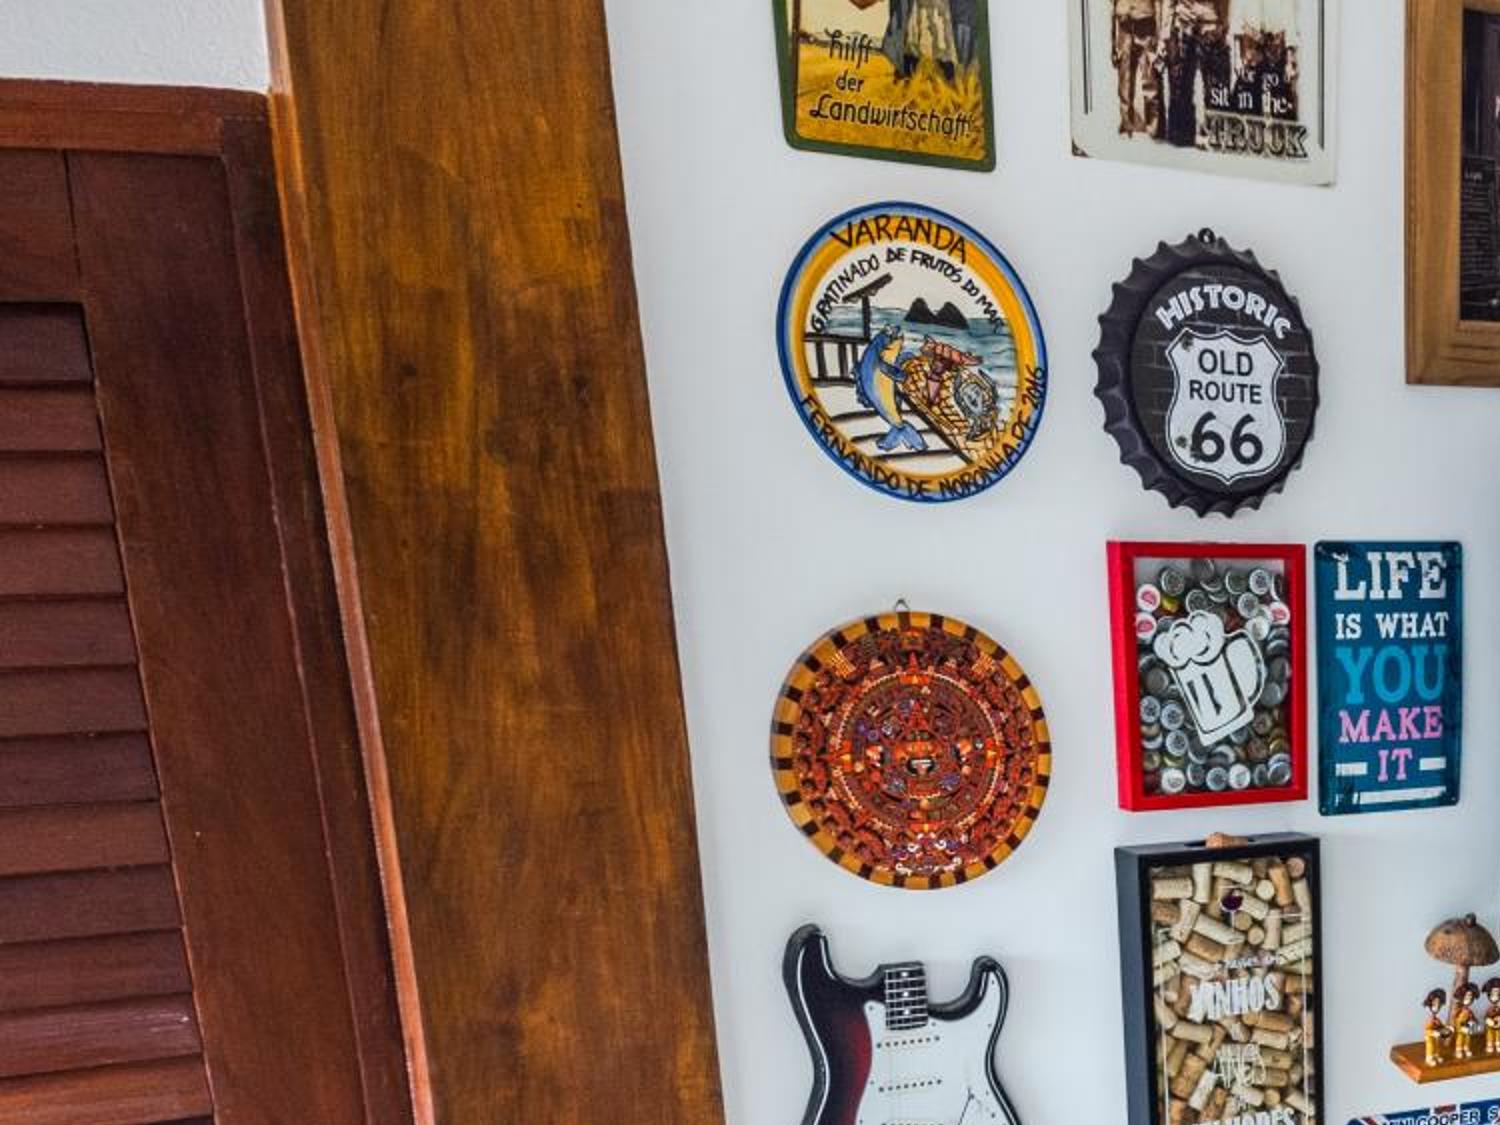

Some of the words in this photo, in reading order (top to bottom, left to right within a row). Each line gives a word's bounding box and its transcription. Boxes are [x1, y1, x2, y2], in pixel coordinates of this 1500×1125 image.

[835, 69, 865, 92] der
[1211, 83, 1230, 107] sit
[1238, 86, 1253, 110] in
[1201, 116, 1308, 158] TRUCK
[830, 214, 968, 265] VARANDA
[810, 253, 881, 335] GRATINADO
[886, 247, 905, 264] DE
[910, 250, 963, 284] FRUTOS
[960, 278, 980, 298] DO
[975, 294, 1005, 334] MAR
[1155, 284, 1292, 340] HISTORIC
[1198, 349, 1254, 377] OLD
[1189, 380, 1263, 404] ROUTE
[800, 392, 900, 491] FERNANDO
[905, 477, 932, 499] DE
[1189, 411, 1264, 465] 66
[1333, 551, 1448, 600] LIFE
[1335, 613, 1362, 640] IS
[1375, 611, 1449, 640] WHAT
[1335, 645, 1447, 704] YOU
[1338, 705, 1444, 743] MAKE
[1377, 748, 1413, 782] IT
[1190, 972, 1280, 1021] VINHOS
[1487, 1105, 1500, 1121] S
